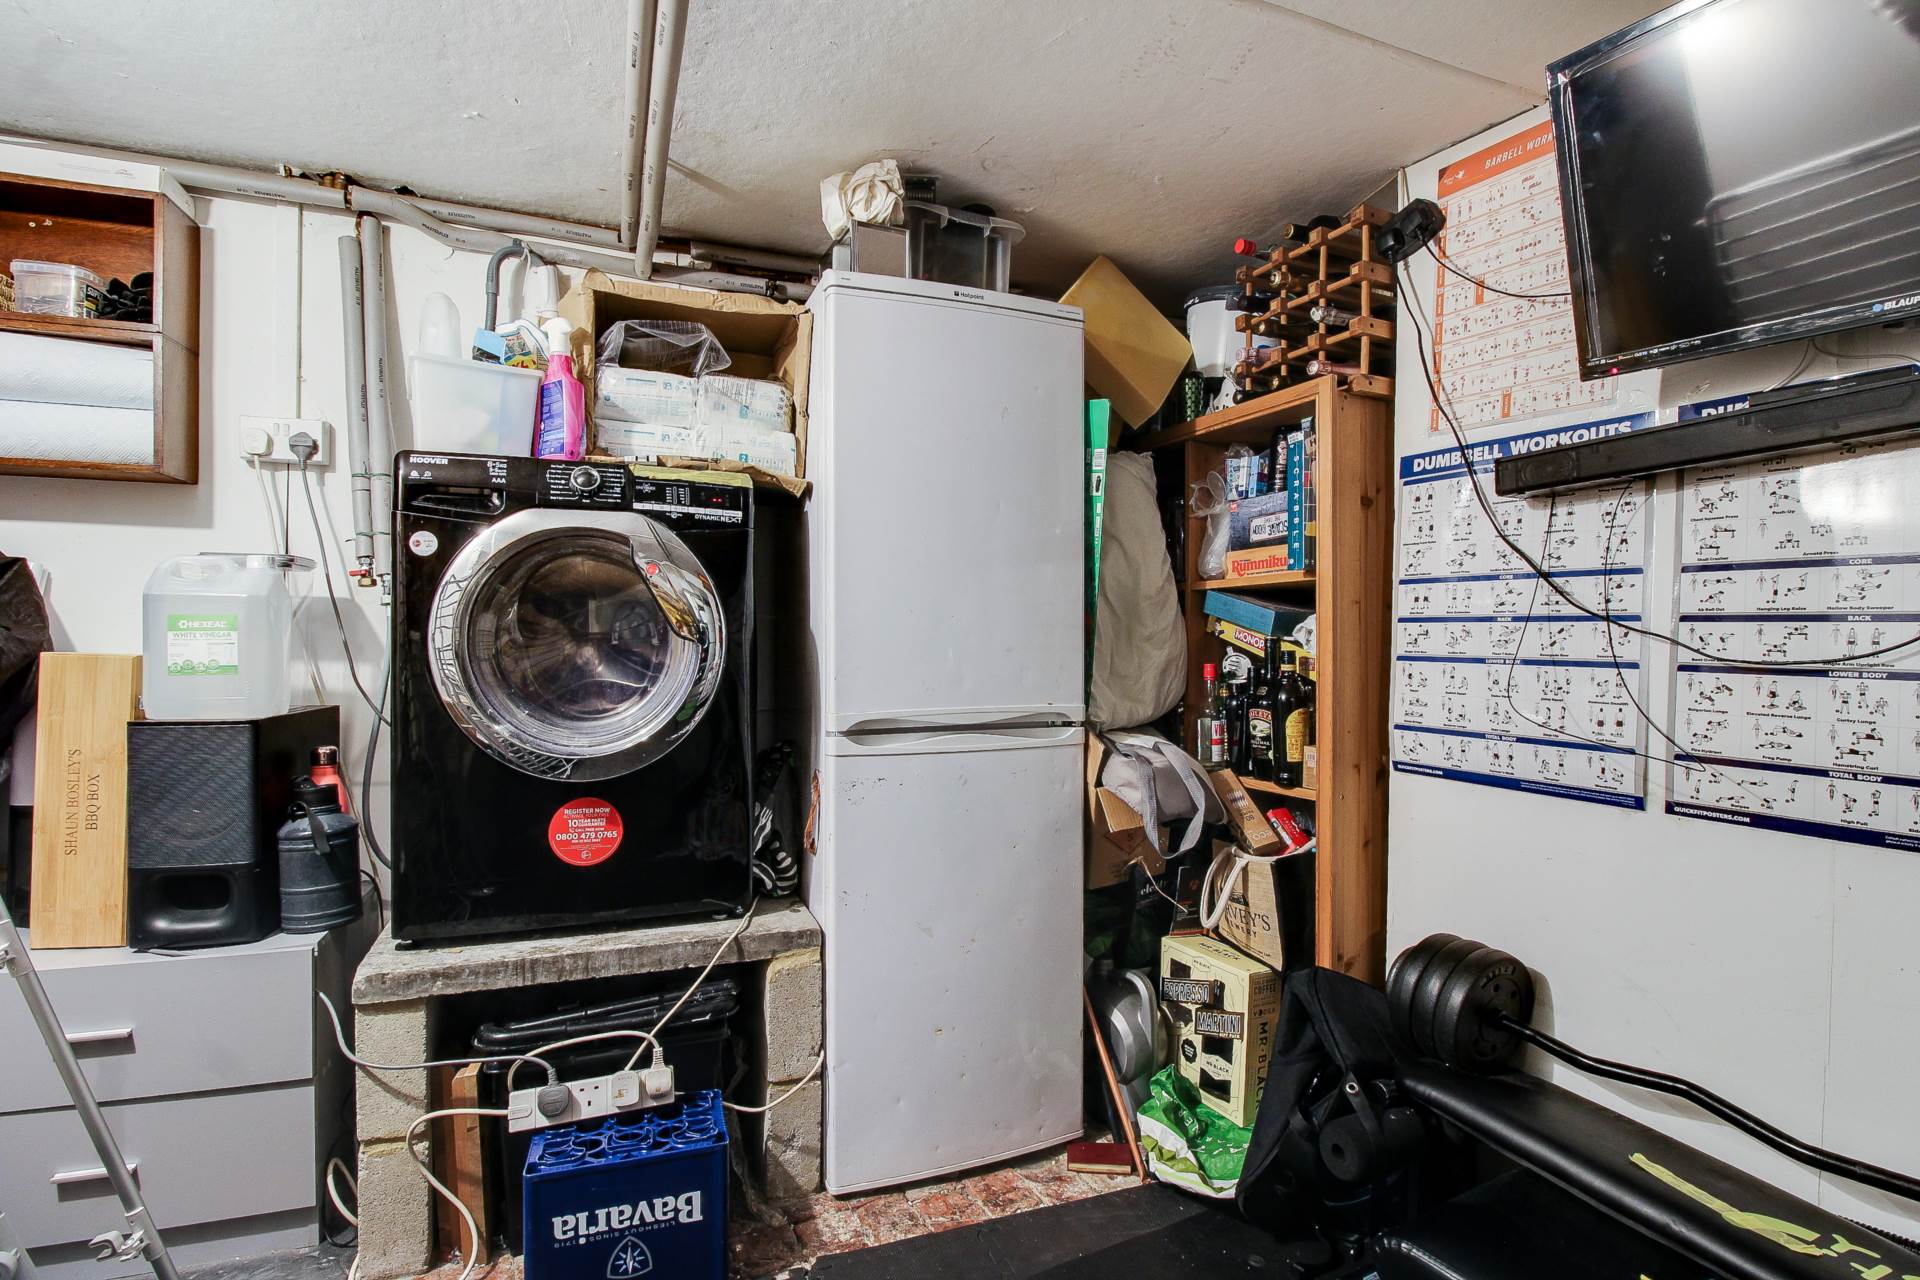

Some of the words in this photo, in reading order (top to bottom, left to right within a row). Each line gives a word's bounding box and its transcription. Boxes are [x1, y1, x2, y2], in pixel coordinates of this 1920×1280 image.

[1485, 145, 1523, 169] BARBELL
[960, 291, 984, 300] Hotpoint
[1413, 444, 1503, 472] DUMBBELL
[1510, 422, 1632, 456] WORKOUTS
[410, 456, 448, 465] HOOVER
[1234, 628, 1265, 649] MONOP
[1828, 771, 1854, 780] TOTAL
[1858, 774, 1883, 782] BODY
[1833, 762, 1864, 770] Hamstring
[66, 749, 81, 808] BOSLEY'S
[87, 774, 100, 800] BOX
[85, 804, 102, 830] BBQ
[1674, 807, 1750, 823] QUICKFITPOSTERS.COM
[64, 812, 78, 856] SHAUN
[1164, 981, 1209, 1003] ESPRESSO
[1254, 983, 1276, 993] COFFEE
[1196, 1012, 1240, 1034] MARTINI
[552, 1190, 703, 1244] Bavaria
[624, 1221, 675, 1235] LIESHOUT
